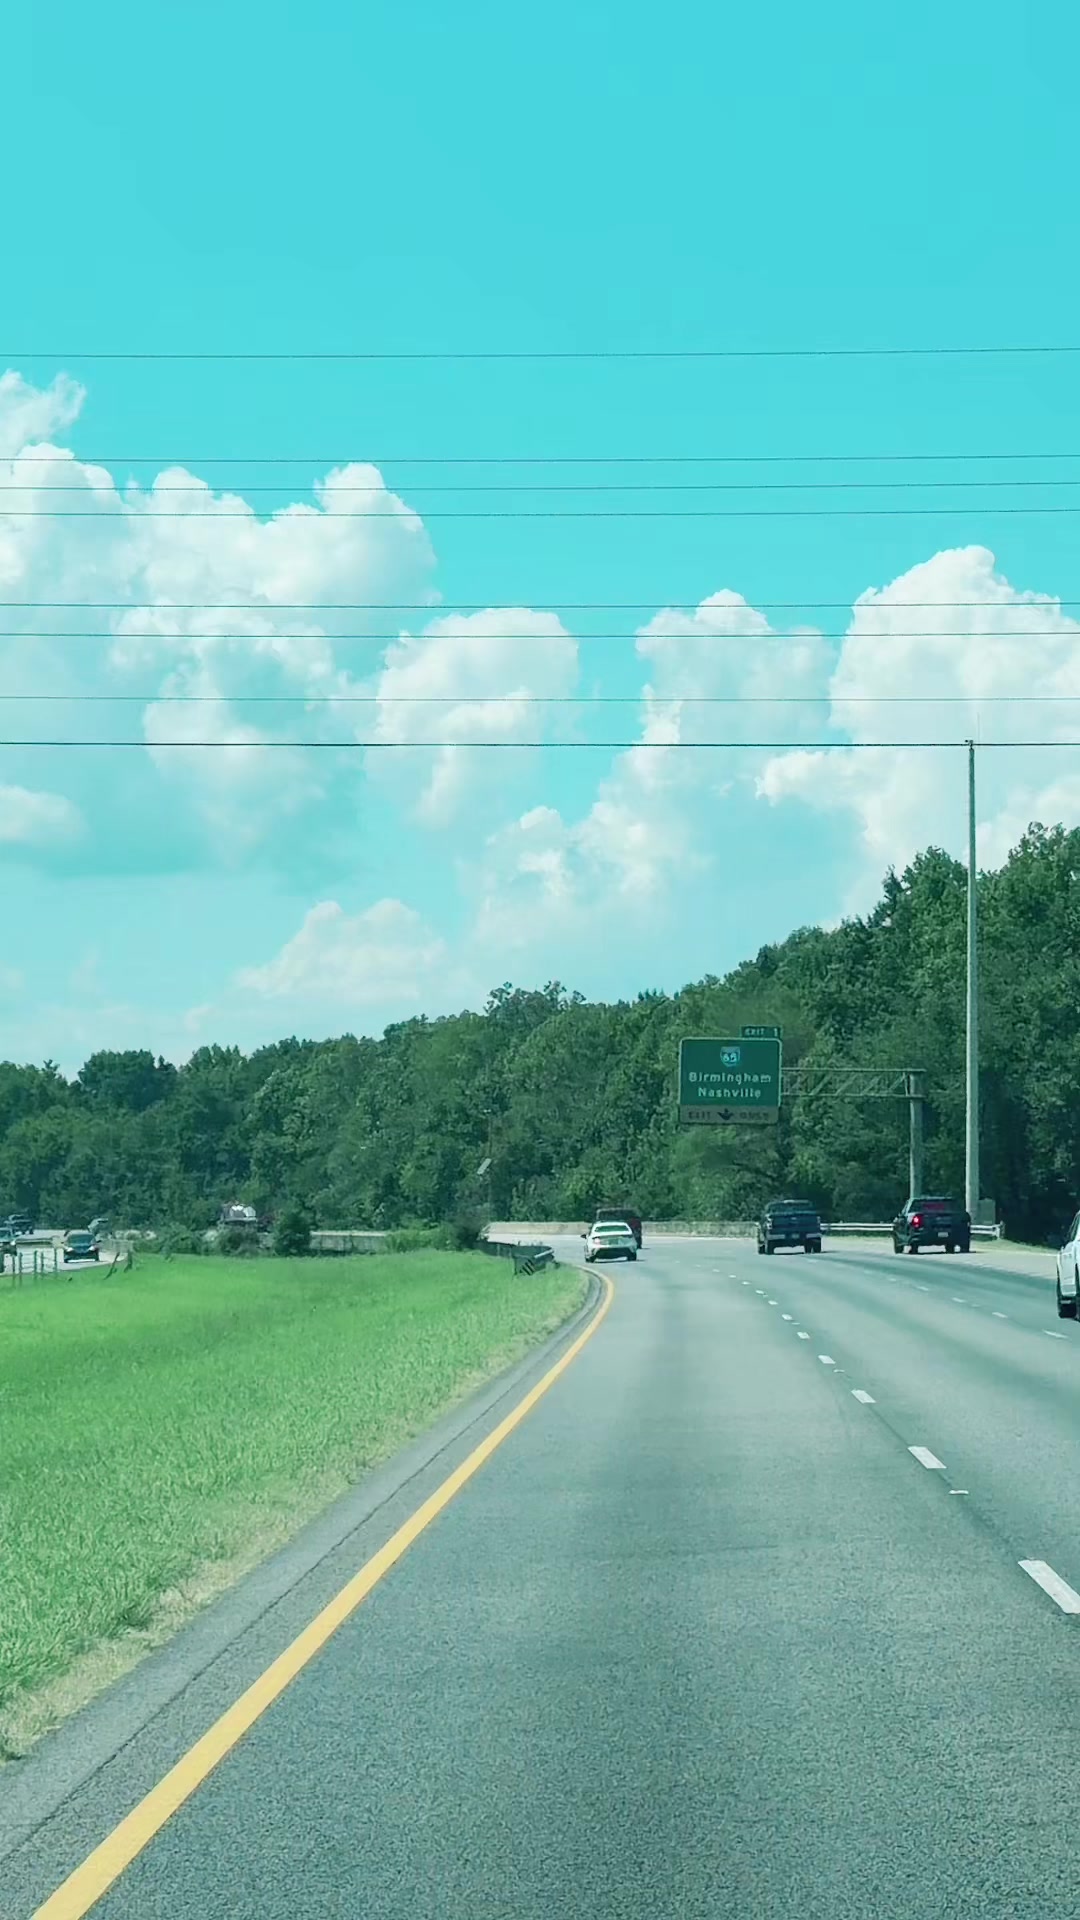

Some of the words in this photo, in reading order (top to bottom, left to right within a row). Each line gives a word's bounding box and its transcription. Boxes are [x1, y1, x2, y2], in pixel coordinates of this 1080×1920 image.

[745, 1028, 765, 1036] EXIT
[722, 1052, 737, 1062] 65
[688, 1072, 771, 1085] Birmingham
[698, 1087, 761, 1098] Nashville
[688, 1111, 711, 1119] EXIT
